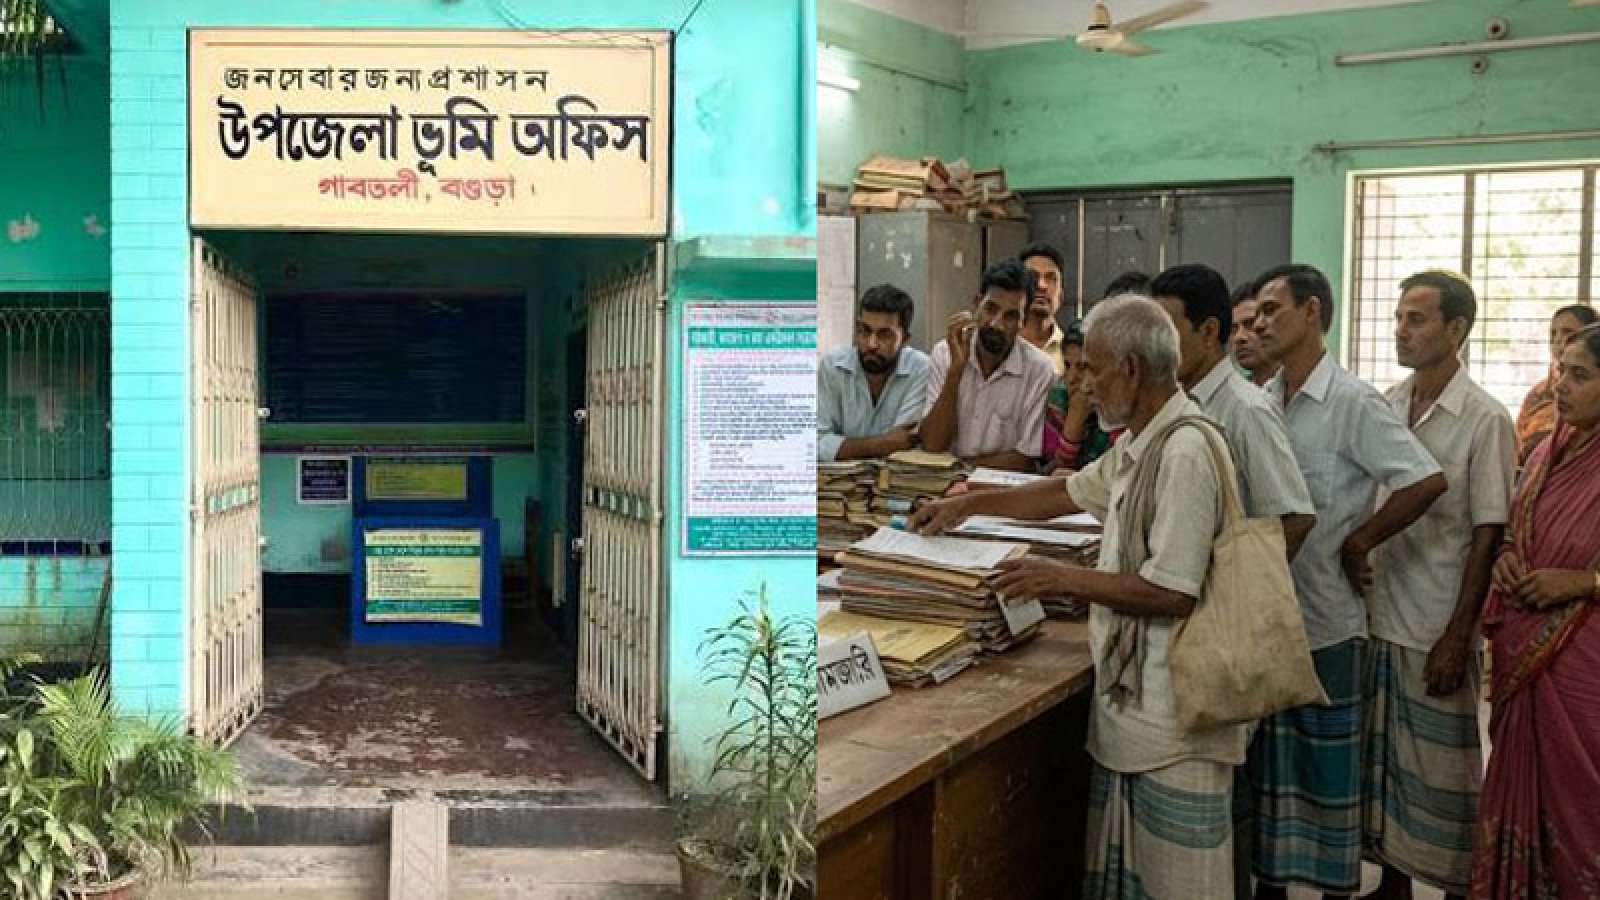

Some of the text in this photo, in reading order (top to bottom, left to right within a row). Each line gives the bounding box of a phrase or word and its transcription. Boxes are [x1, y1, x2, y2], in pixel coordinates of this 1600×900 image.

[216, 94, 649, 177] উপজেলা ভূমি অফিস
